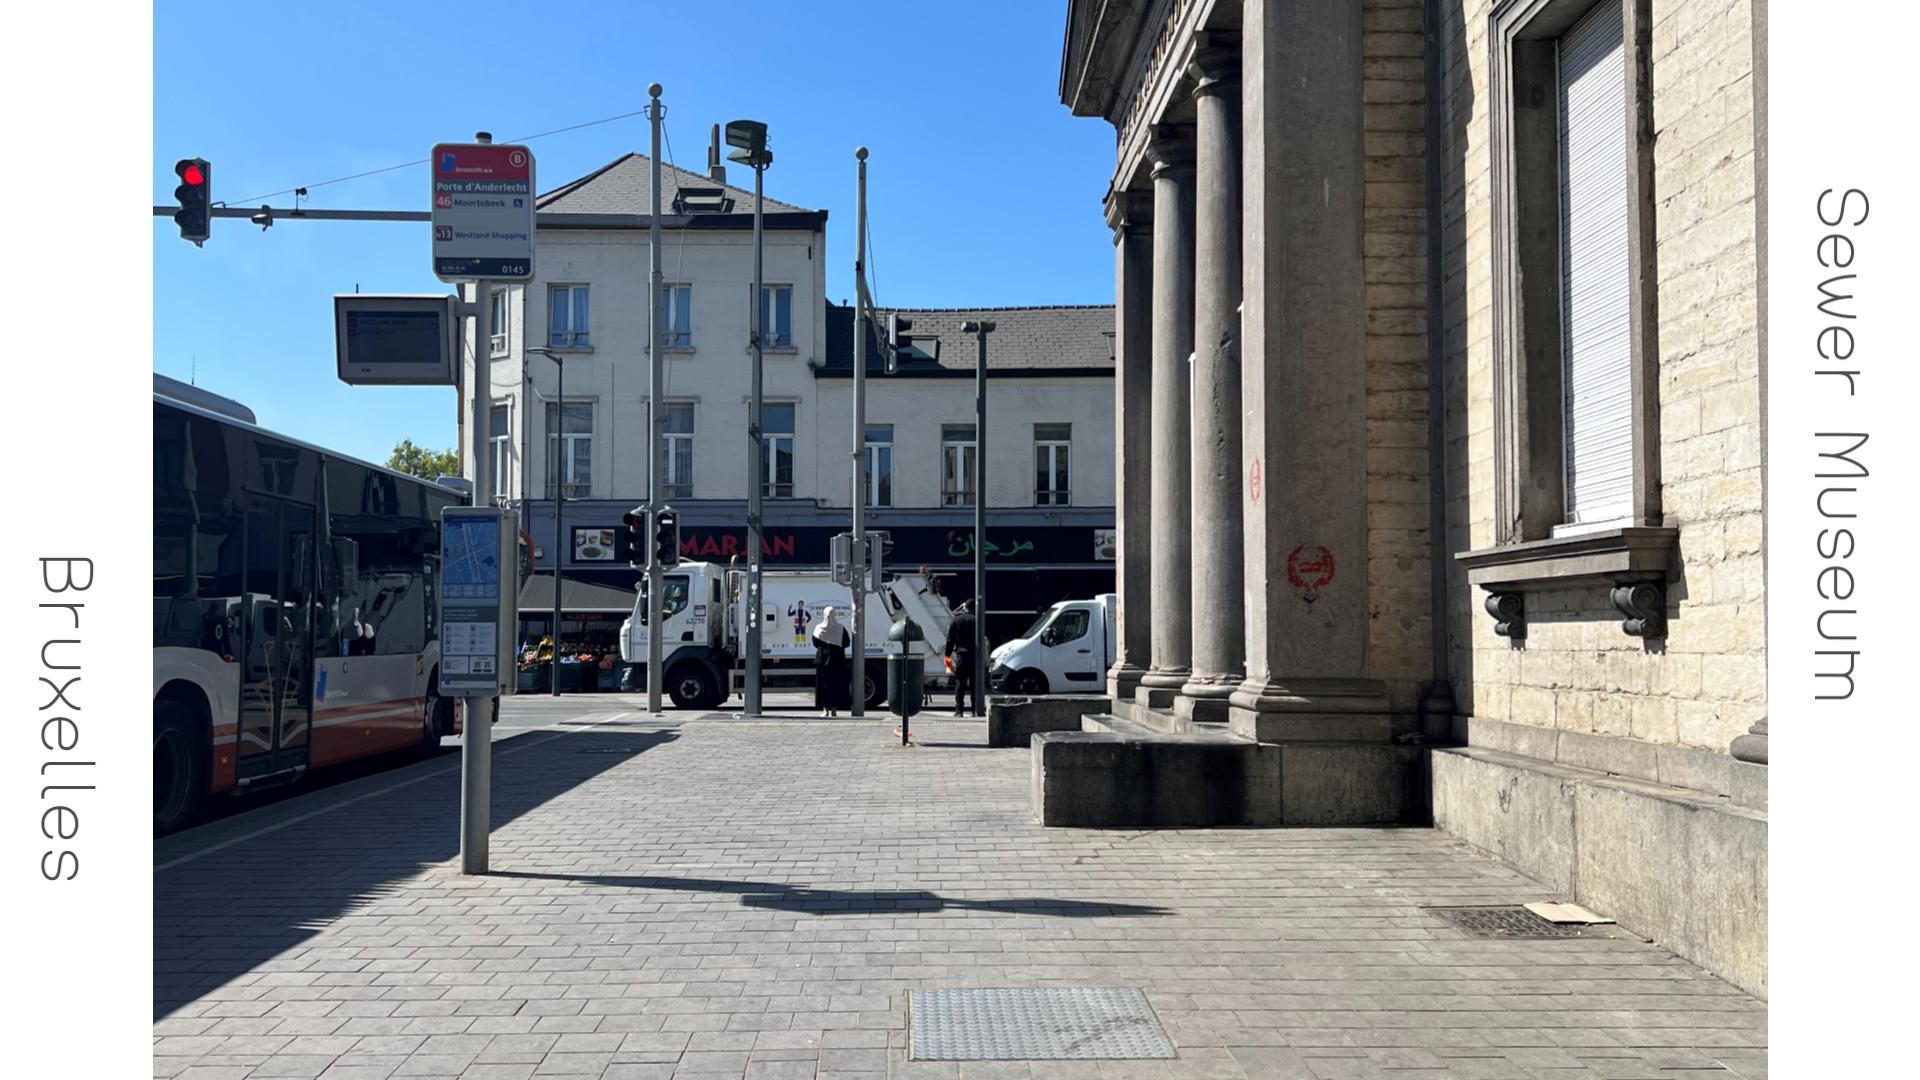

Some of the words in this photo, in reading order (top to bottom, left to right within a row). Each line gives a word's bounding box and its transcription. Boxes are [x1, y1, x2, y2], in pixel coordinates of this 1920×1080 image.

[437, 182, 462, 191] Porte
[465, 183, 527, 192] d'Anderlecht
[437, 196, 452, 207] 46
[454, 199, 506, 208] Moortebeek
[455, 231, 490, 239] Westland
[491, 232, 527, 241] Shopping
[502, 265, 525, 275] 0145
[679, 535, 794, 556] MARJAN
